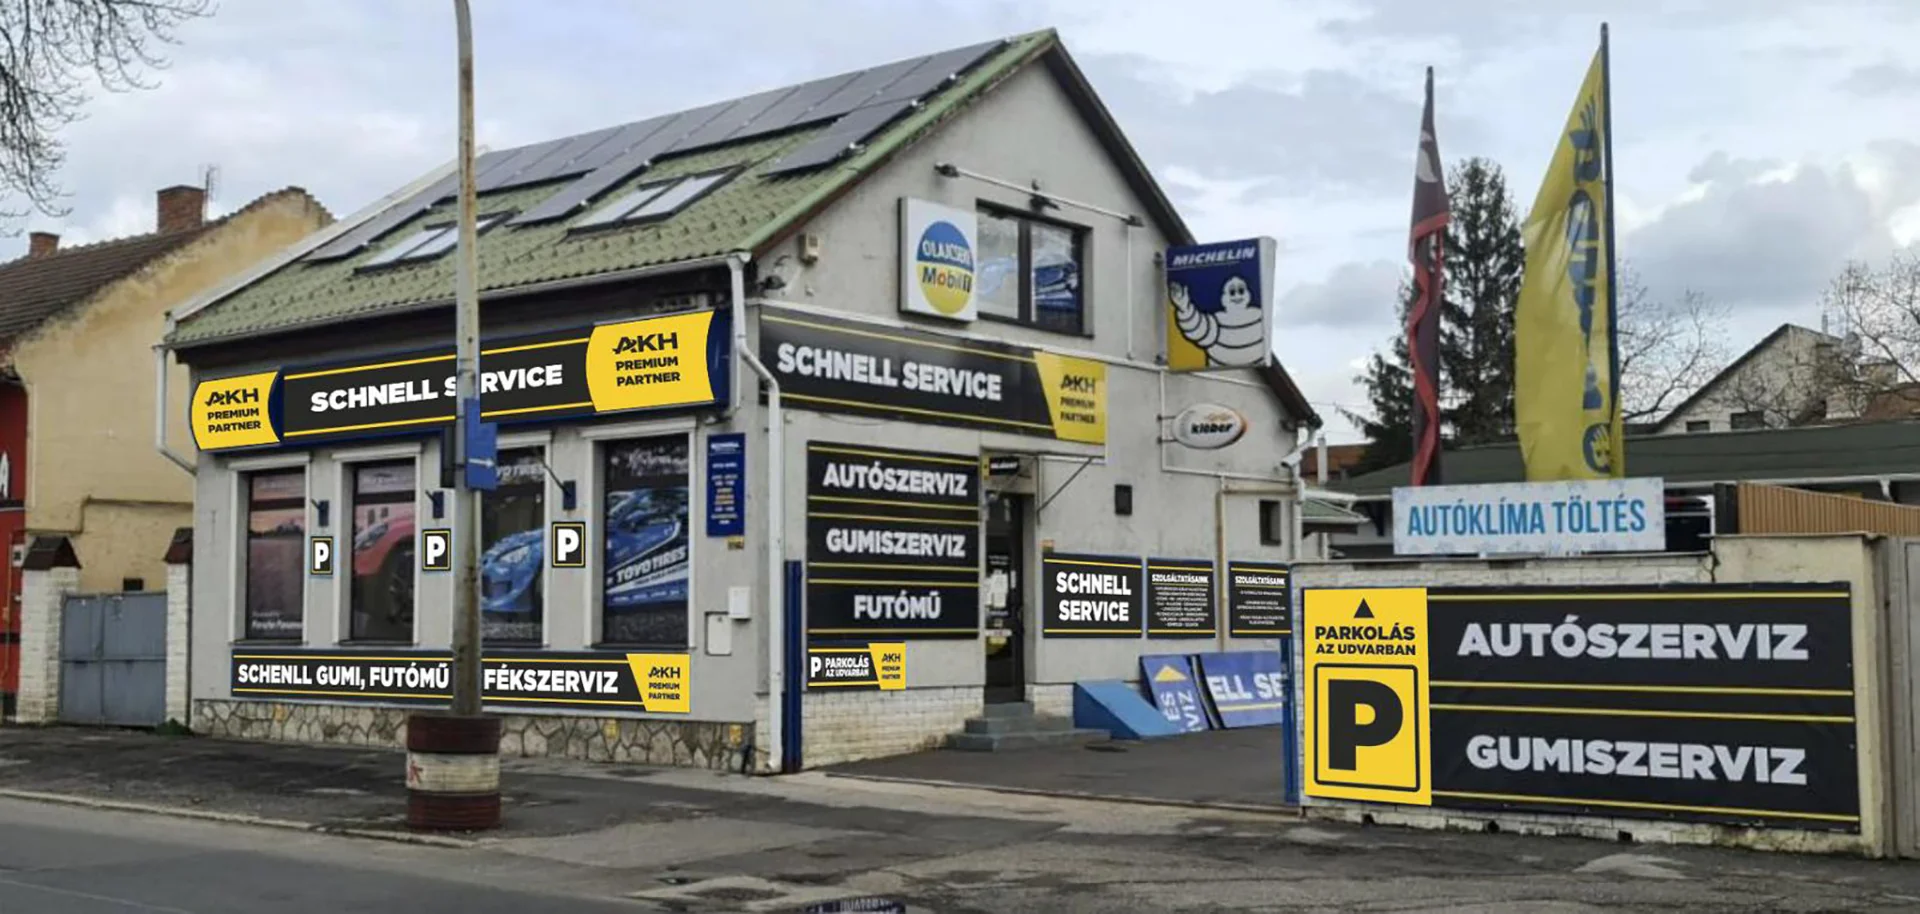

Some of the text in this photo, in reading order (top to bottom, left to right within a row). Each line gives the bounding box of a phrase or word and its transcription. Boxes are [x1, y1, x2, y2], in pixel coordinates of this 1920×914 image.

[1173, 247, 1255, 265] MICHELIN
[613, 332, 678, 354] AKH
[616, 356, 678, 371] PREMIUM
[777, 343, 1001, 400] SCHNELL SERVICE
[311, 363, 563, 411] SCHNELL SRVICE
[617, 372, 680, 386] PARTNER
[1061, 375, 1095, 392] AKH
[205, 388, 259, 406] AKH
[208, 407, 259, 420] PREMIUM
[208, 420, 261, 433] PARTNER
[823, 460, 967, 496] AUTÓSZERVIZ
[1408, 494, 1645, 536] AUTÓKLÍMA TÖLTÉS
[427, 536, 445, 564] P
[558, 529, 579, 561] P
[826, 529, 965, 557] GUMISZERVIZ
[315, 543, 329, 569] P
[1056, 572, 1131, 595] SCHNELL
[855, 590, 940, 618] FUTÓMŰ
[1059, 600, 1129, 621] SERVICE
[1316, 623, 1415, 640] PARKOLÁS
[1458, 615, 1808, 659] AUTÓSZERVIZ
[1316, 644, 1415, 655] AZ UDVARBAN
[239, 662, 449, 690] SCHENLL GUMI, FUTÓMŰ
[649, 667, 680, 678] AKH
[811, 654, 870, 677] P PARKOLÁS
[825, 669, 834, 677] AZ
[484, 664, 618, 693] FÉKSZERVIZ
[1328, 679, 1403, 771] P
[1467, 735, 1806, 784] GUMISZERVIZ
